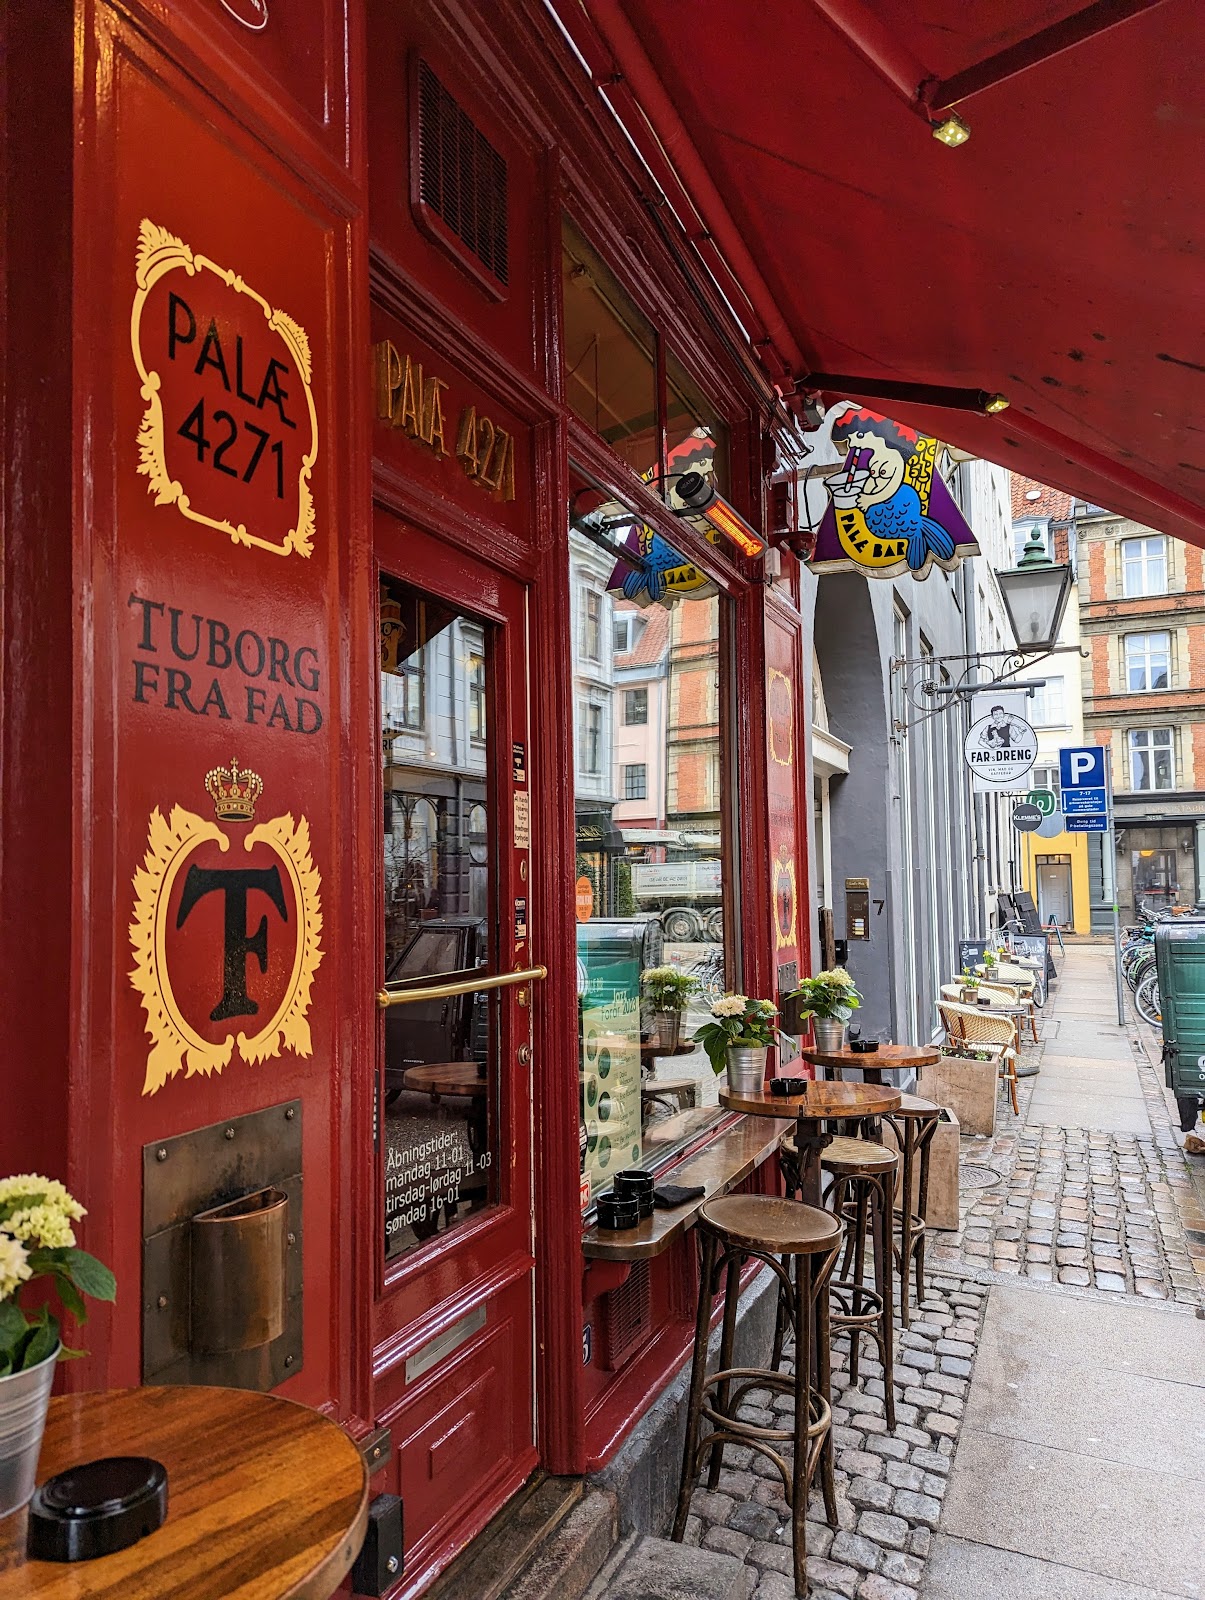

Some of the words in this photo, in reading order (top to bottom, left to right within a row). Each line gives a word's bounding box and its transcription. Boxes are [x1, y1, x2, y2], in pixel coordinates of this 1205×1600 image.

[168, 291, 297, 430] PALÆ
[377, 339, 451, 461] PALÆ
[456, 405, 516, 501] 4271
[176, 396, 285, 500] 4271
[872, 541, 906, 558] BAR
[127, 592, 320, 692] TUBORG
[132, 659, 232, 720] FRA
[244, 685, 323, 735] FAD
[996, 749, 1032, 762] DRENG
[1070, 751, 1096, 784] P
[872, 899, 885, 915] 7
[612, 987, 628, 1003] Jazz
[386, 1131, 459, 1171] Åbningstider:
[386, 1162, 432, 1193] mandag
[434, 1144, 464, 1172] 11-01
[385, 1167, 462, 1214] tirsdag-lørdag
[385, 1203, 427, 1235] søndag
[430, 1184, 461, 1214] 16-01
